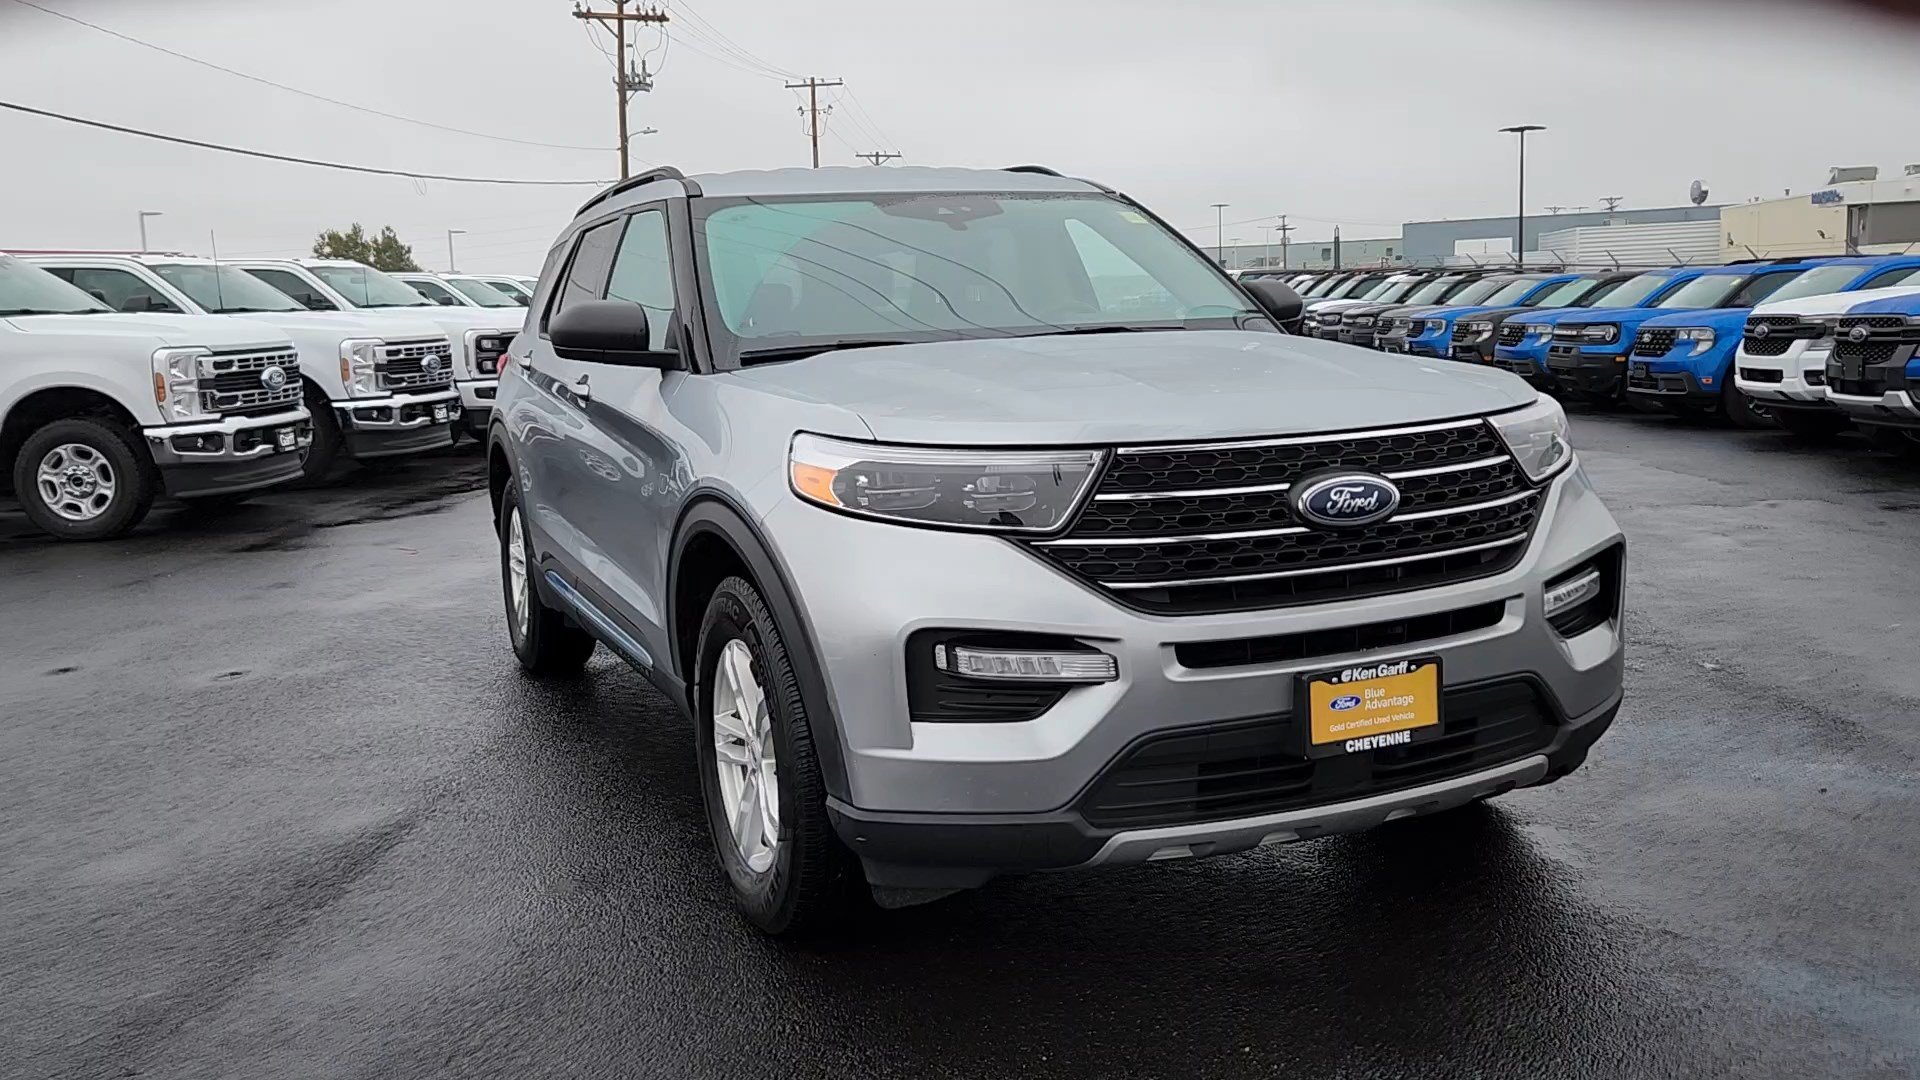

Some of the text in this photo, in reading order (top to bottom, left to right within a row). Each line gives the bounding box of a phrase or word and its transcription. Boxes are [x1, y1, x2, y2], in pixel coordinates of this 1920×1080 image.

[1326, 486, 1379, 515] Ford
[1352, 661, 1408, 682] Ken Garff
[1364, 688, 1386, 699] Blue
[1364, 695, 1415, 711] Advantage
[1329, 711, 1415, 732] Gold Certified Used Vehicle
[1345, 730, 1411, 752] CHEYENNE
